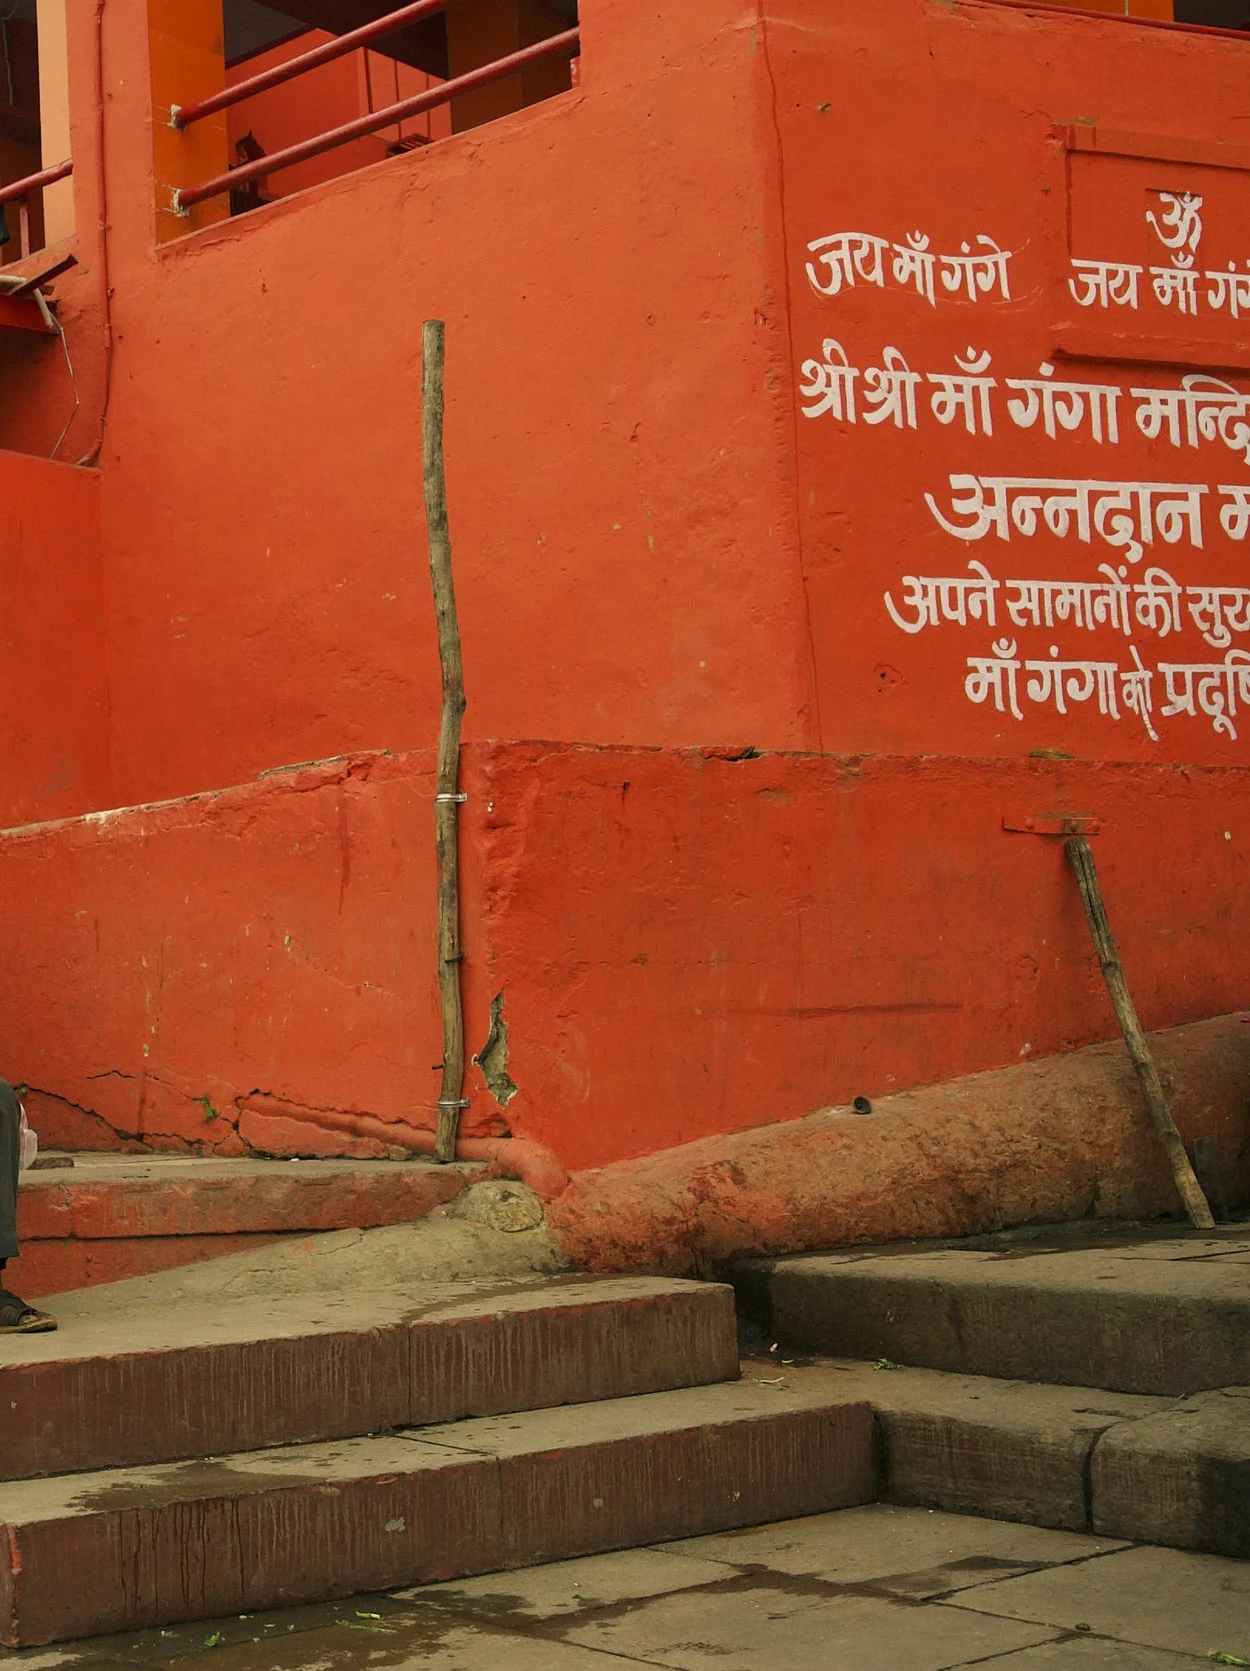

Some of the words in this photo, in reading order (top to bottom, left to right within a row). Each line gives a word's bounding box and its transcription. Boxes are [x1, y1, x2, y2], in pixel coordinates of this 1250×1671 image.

[806, 232, 889, 296] जय
[940, 235, 1013, 302] गंगे
[1069, 258, 1143, 309] जय
[1006, 361, 1122, 444] गंगा
[1130, 374, 1250, 466] मन्दि
[884, 560, 1000, 634] अपने
[1006, 563, 1132, 636] सामानों
[1134, 567, 1183, 638] की
[1025, 645, 1121, 720] गंगा
